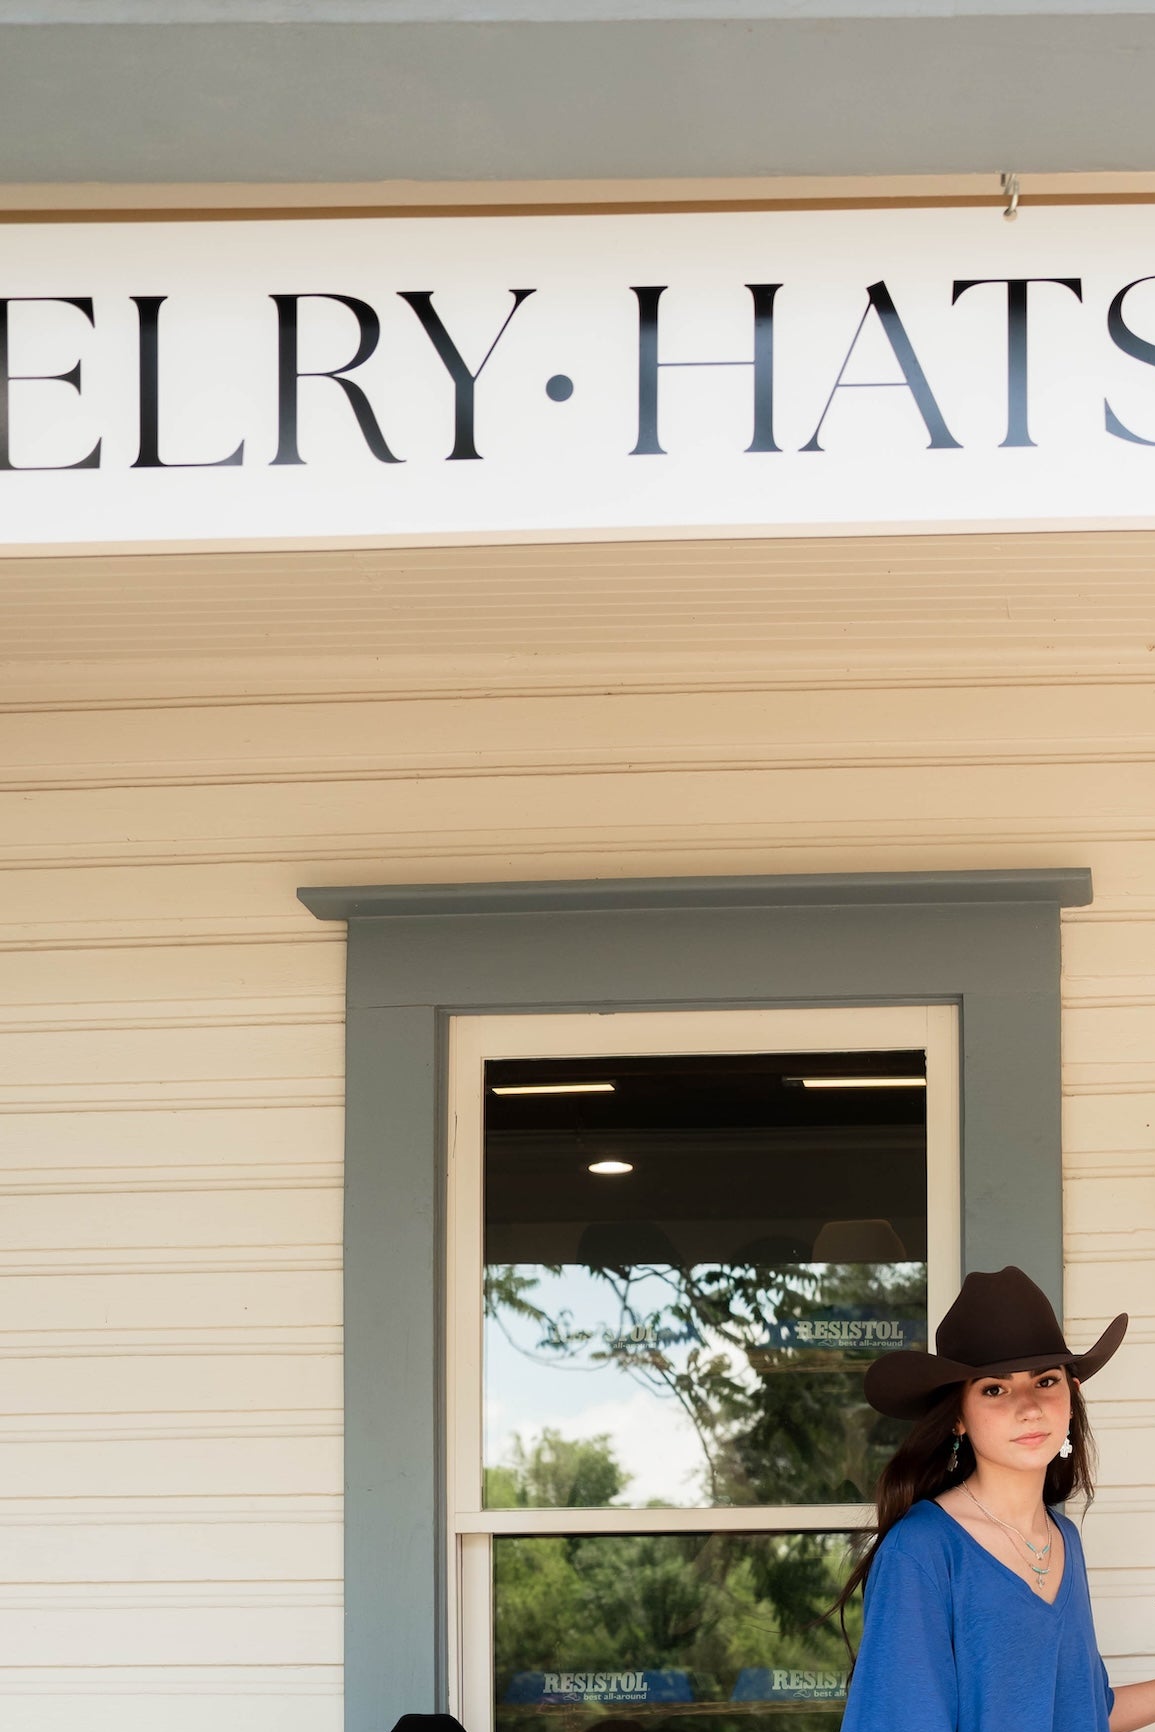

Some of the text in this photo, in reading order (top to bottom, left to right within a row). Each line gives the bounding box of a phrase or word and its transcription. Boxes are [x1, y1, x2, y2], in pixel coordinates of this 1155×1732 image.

[797, 1320, 904, 1340] RESISTOL
[838, 1339, 904, 1348] best all-around
[543, 1671, 648, 1693] RESISTOL
[772, 1669, 849, 1690] RESIST
[583, 1692, 647, 1701] best all-around
[813, 1690, 832, 1698] best
